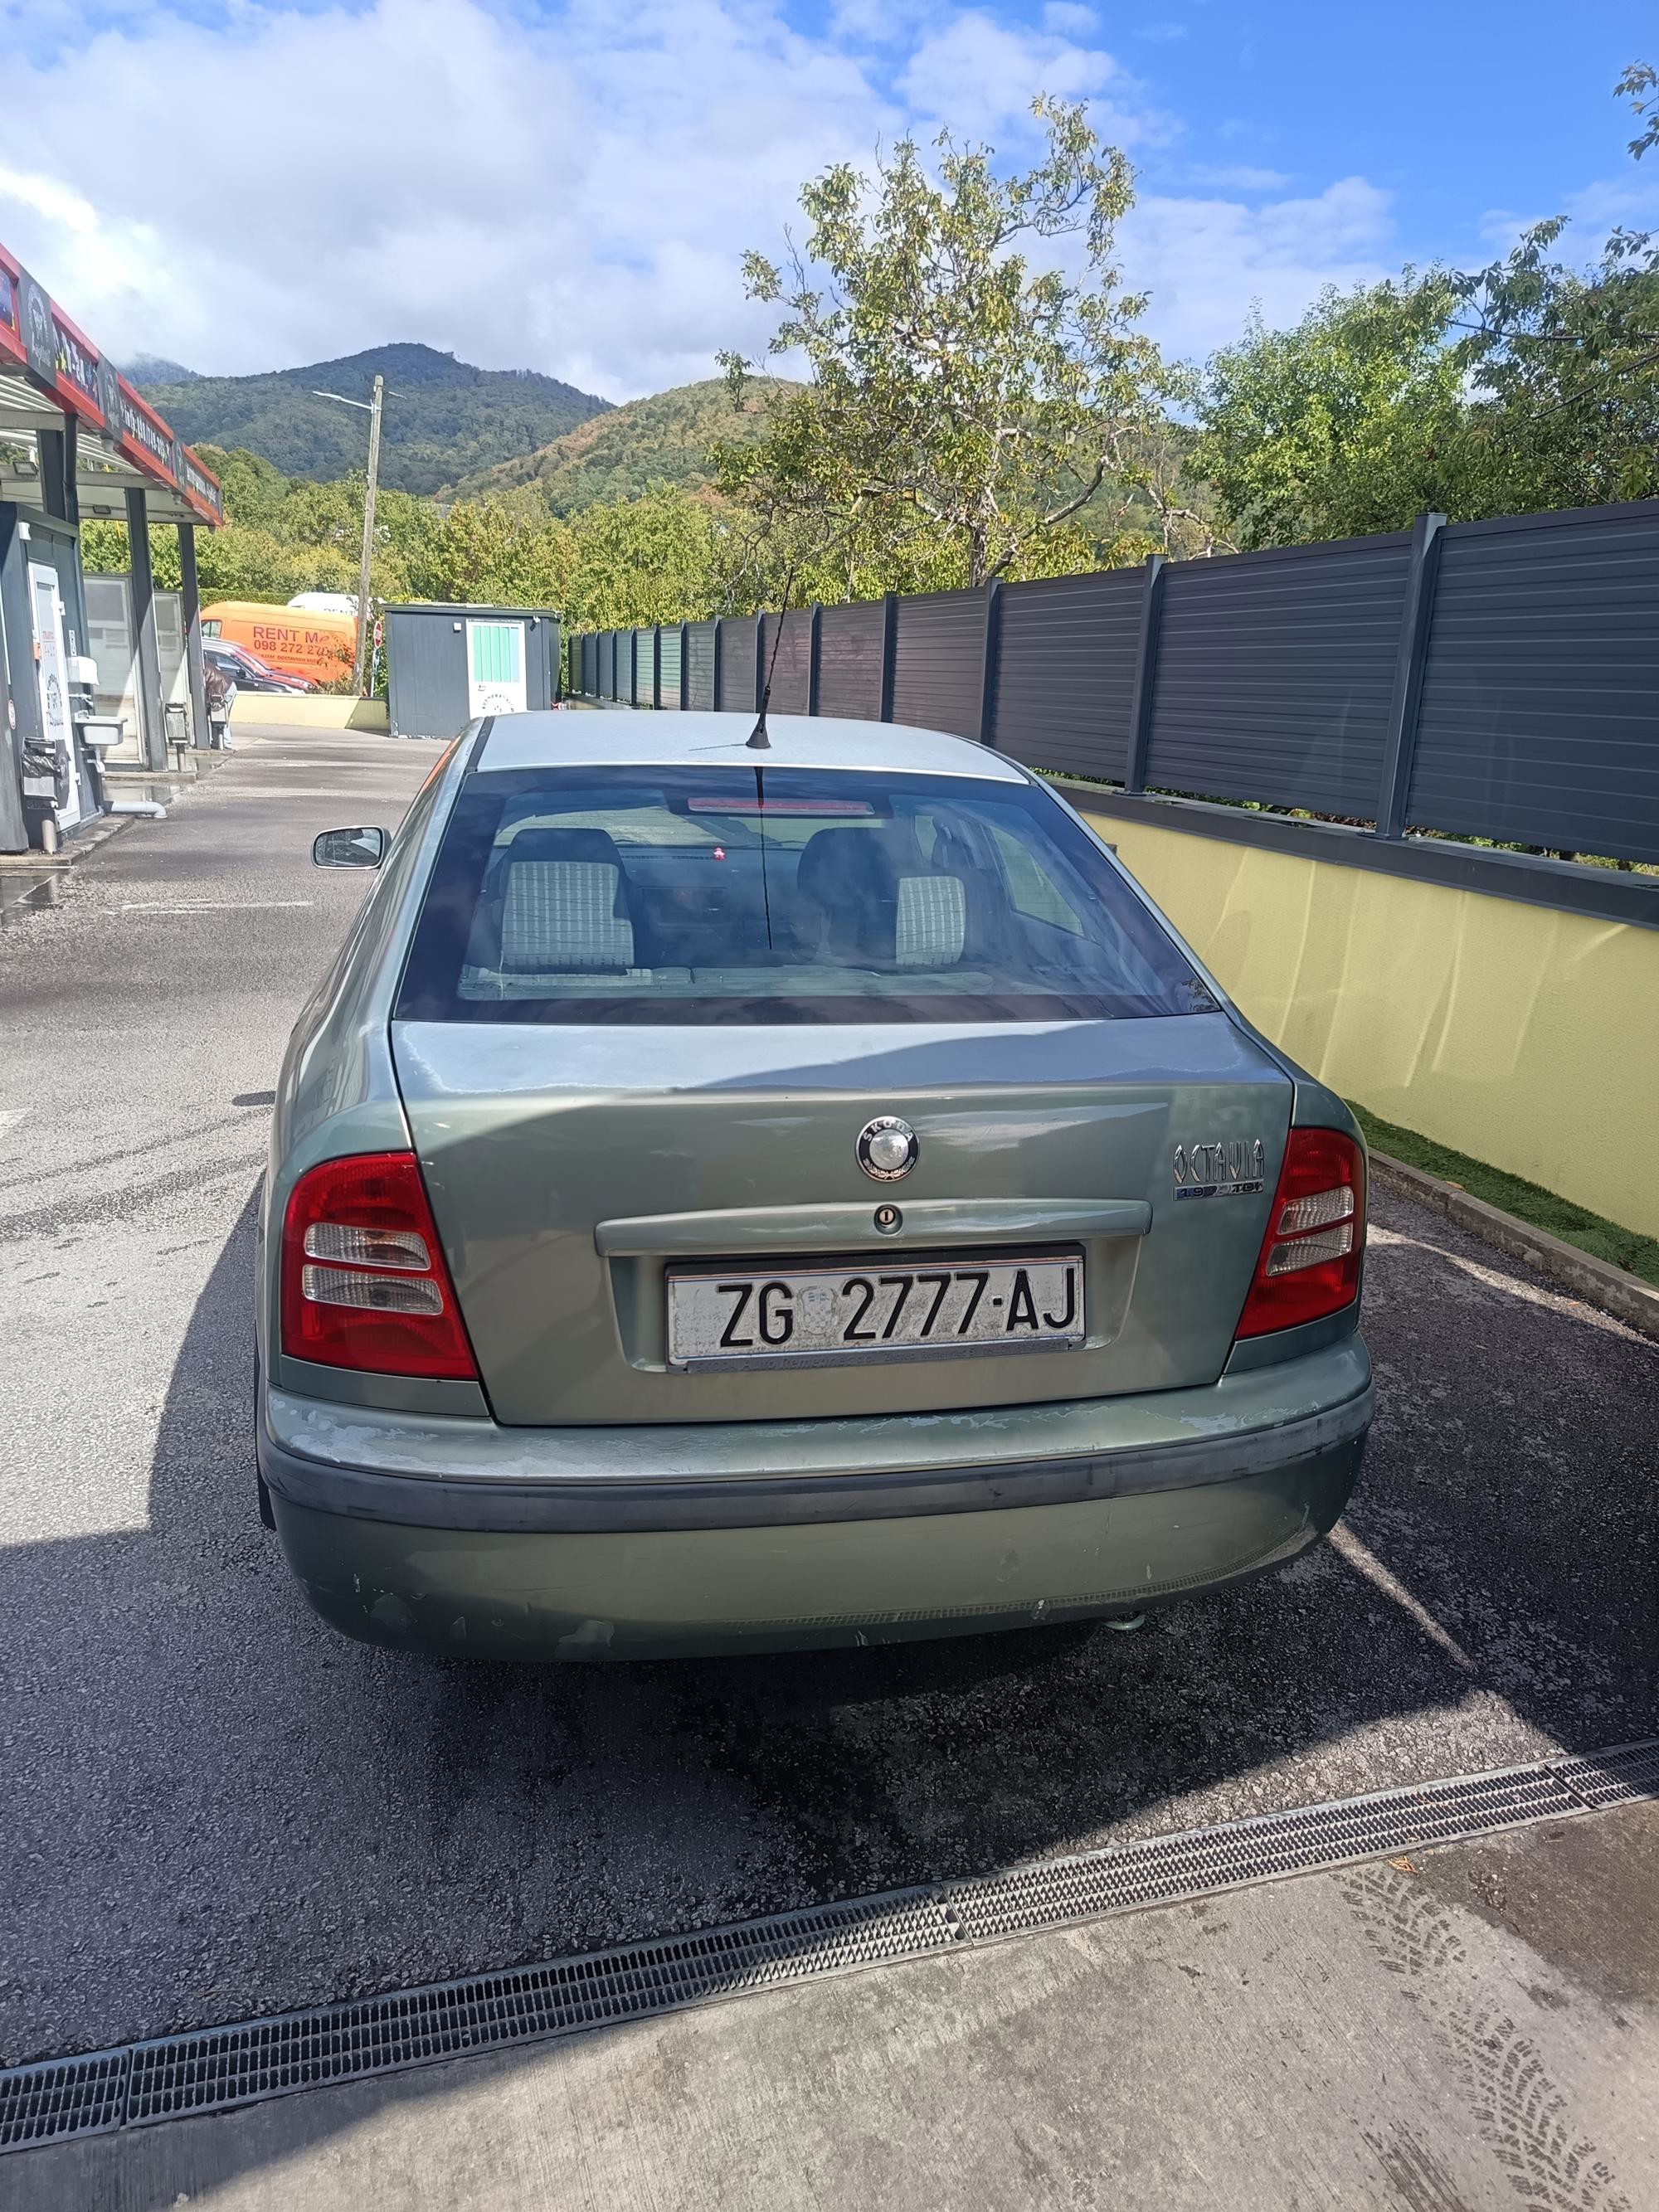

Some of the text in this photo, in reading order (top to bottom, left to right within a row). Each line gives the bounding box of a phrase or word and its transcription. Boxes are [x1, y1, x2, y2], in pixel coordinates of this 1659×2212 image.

[253, 626, 300, 642] RENT
[254, 639, 276, 651] 098
[280, 642, 304, 654] 272
[1173, 1139, 1265, 1184] OCTAVIA
[716, 1281, 795, 1348] ZG
